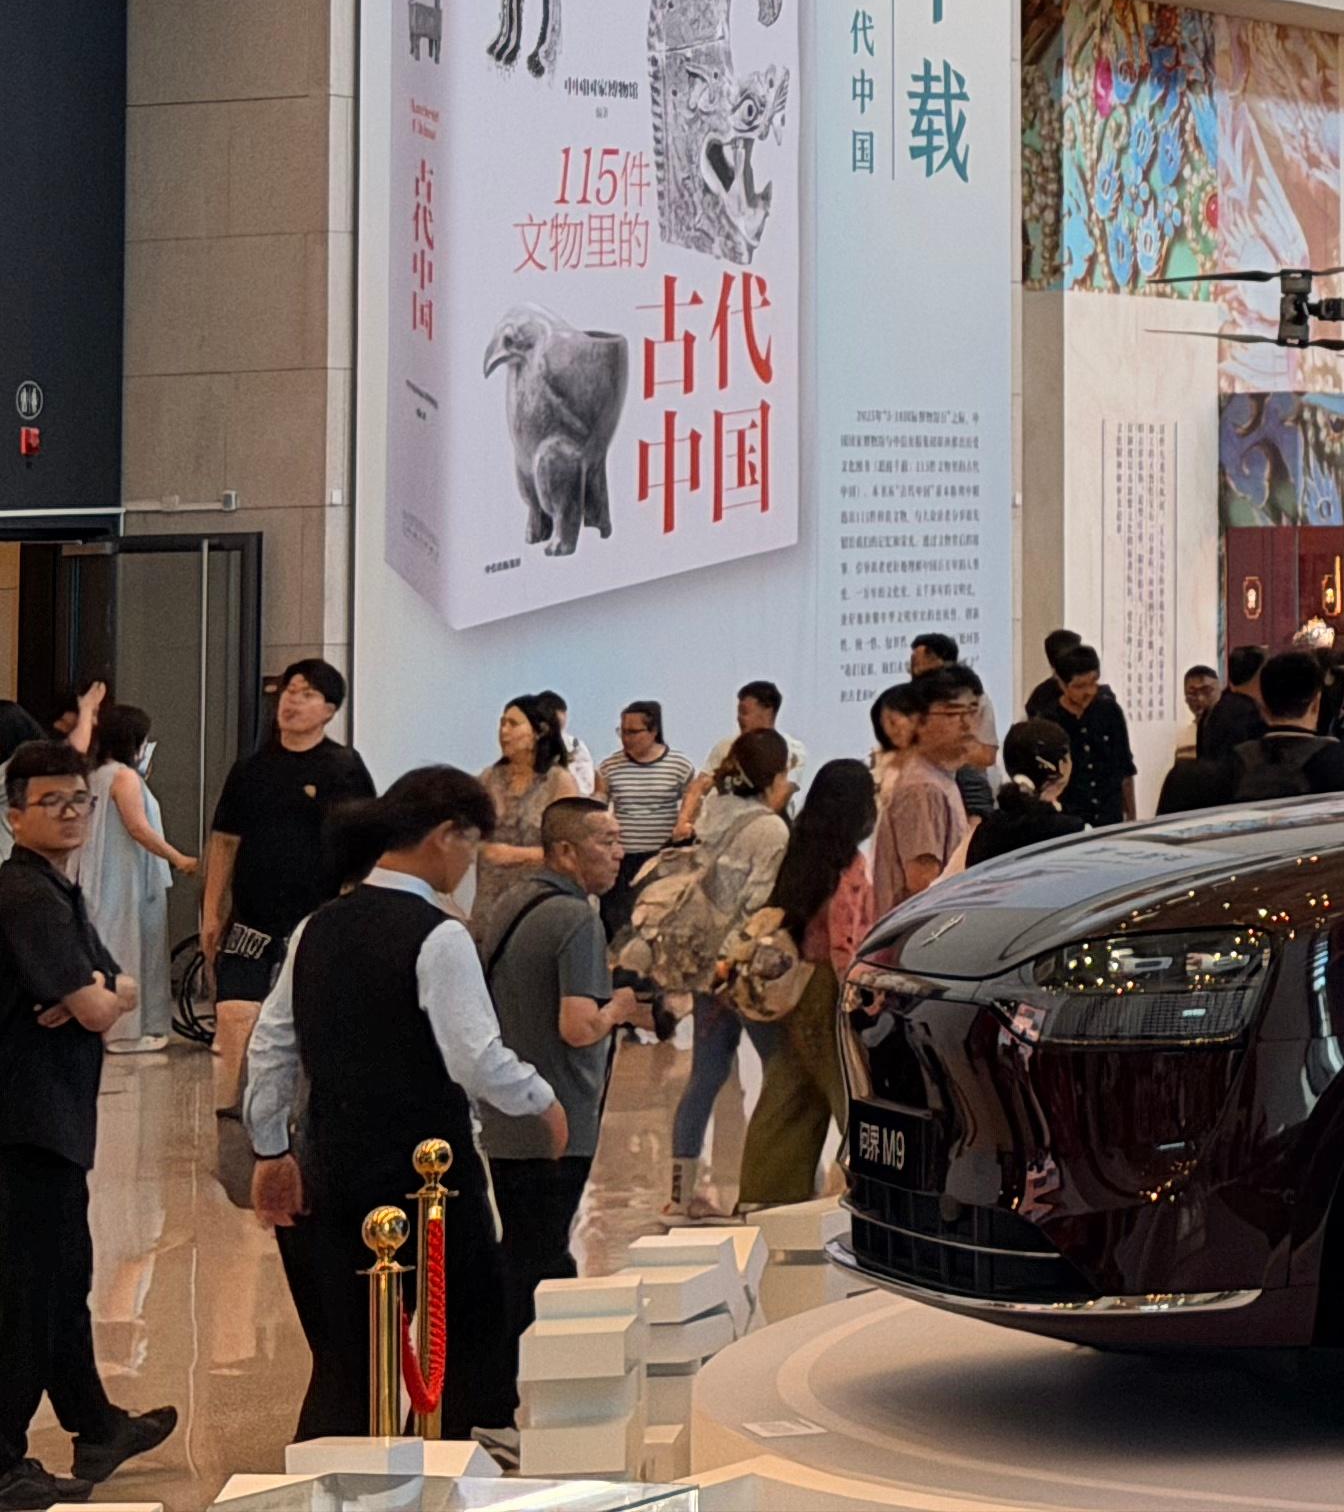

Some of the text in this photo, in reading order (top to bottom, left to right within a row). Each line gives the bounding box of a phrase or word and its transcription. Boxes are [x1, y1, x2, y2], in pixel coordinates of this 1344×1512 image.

[554, 145, 652, 207] 115件
[412, 159, 435, 341] 古代中国
[513, 213, 650, 273] 文物里的
[635, 271, 774, 401] 古代
[637, 399, 772, 535] 中国
[859, 1120, 905, 1171] 问界 M9
